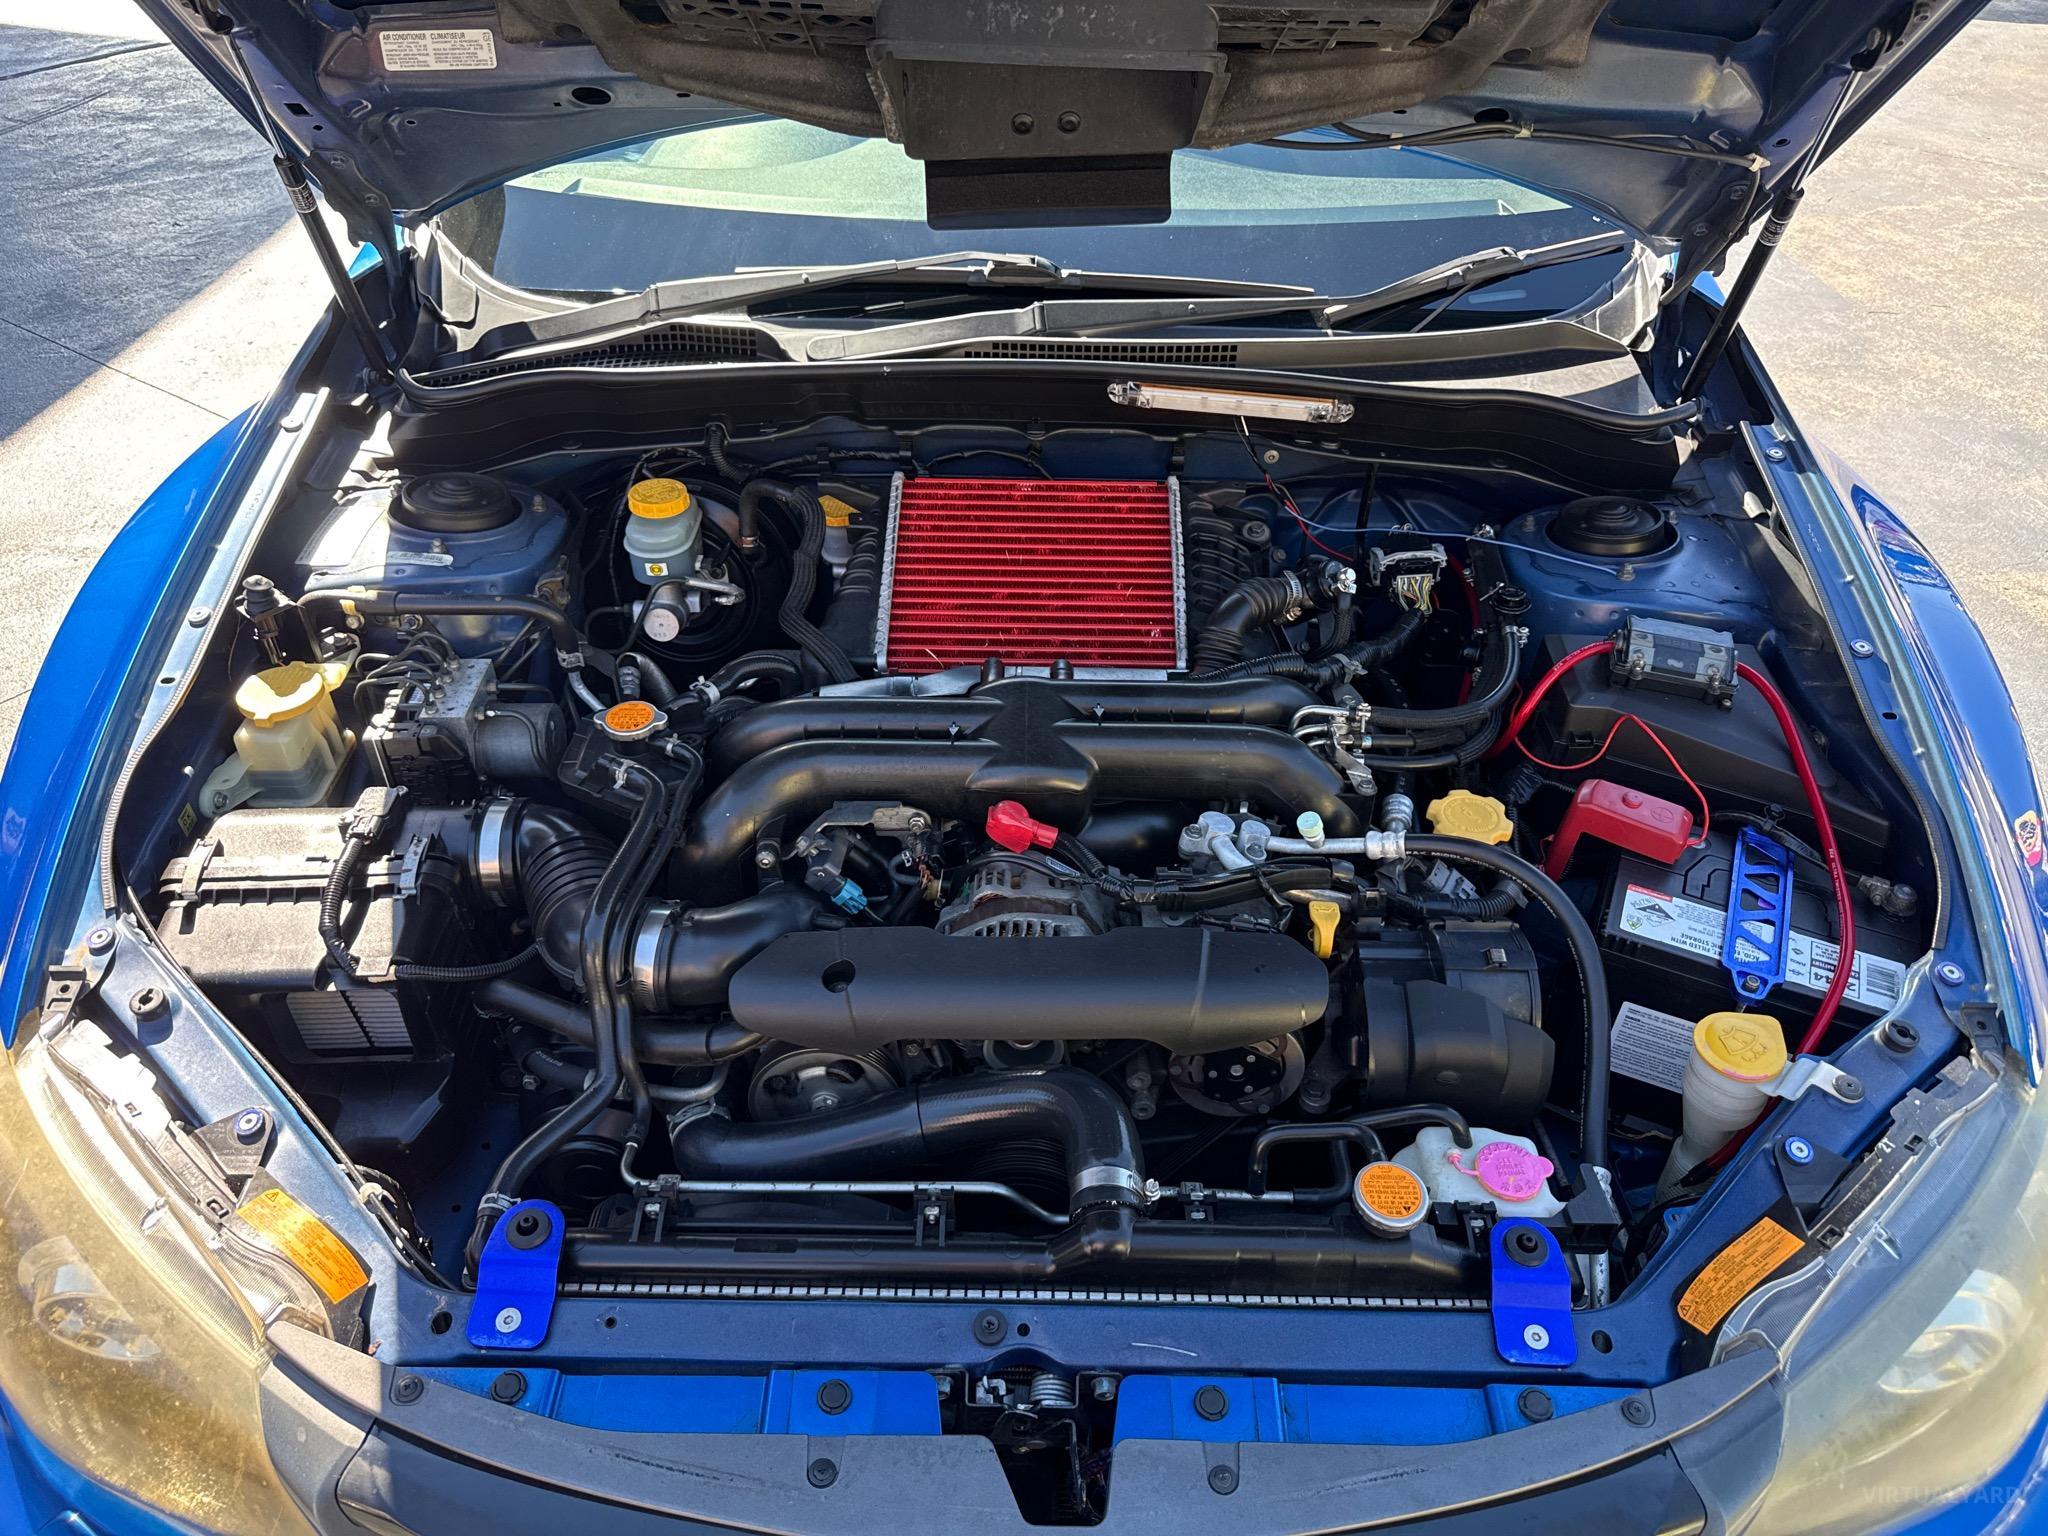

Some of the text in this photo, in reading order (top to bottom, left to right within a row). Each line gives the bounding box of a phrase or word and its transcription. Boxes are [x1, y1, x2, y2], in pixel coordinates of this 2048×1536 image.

[1670, 936, 1687, 946] WITH
[1680, 933, 1708, 946] STORAGE
[1688, 940, 1711, 953] FILLED
